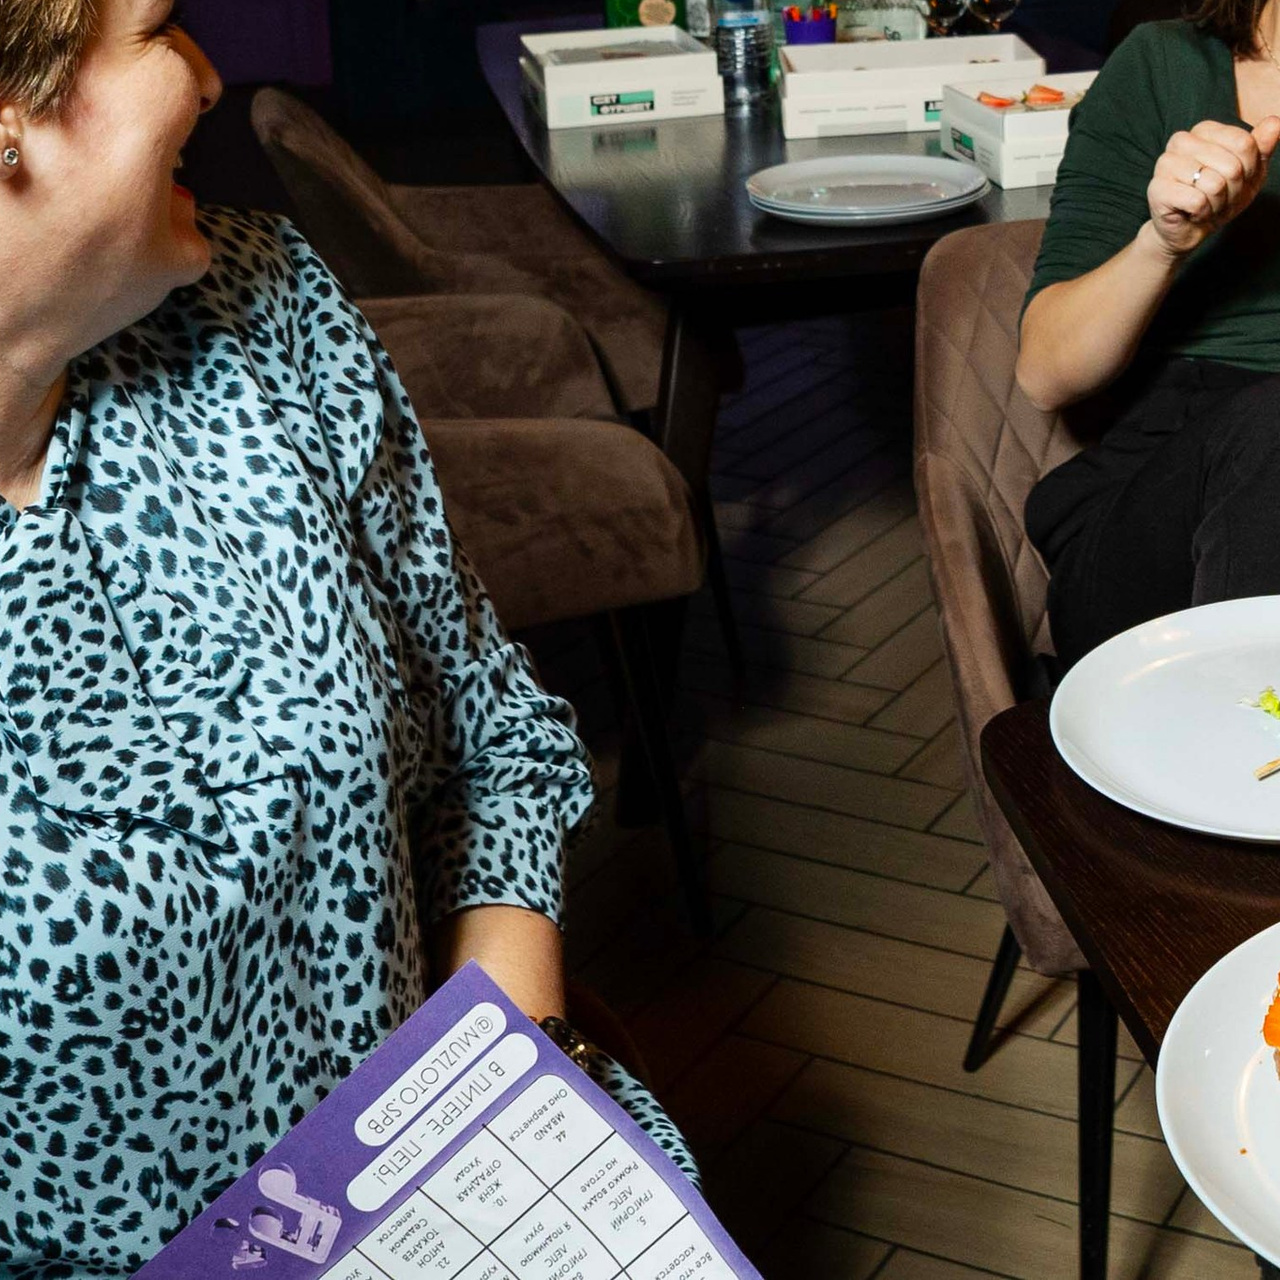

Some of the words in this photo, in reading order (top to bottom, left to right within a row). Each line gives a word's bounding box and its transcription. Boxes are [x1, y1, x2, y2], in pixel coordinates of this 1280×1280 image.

[367, 1015, 495, 1134] @MUZLOTO.SPB
[487, 1059, 506, 1078] В
[427, 1076, 493, 1136] ПИТЕРЕ
[547, 1087, 568, 1107] Она
[508, 1103, 549, 1142] вернется
[533, 1110, 566, 1141] MBAND
[551, 1129, 567, 1143] 44.
[372, 1142, 423, 1186] ПЕТЬ!
[452, 1156, 482, 1184] Уходи
[604, 1157, 618, 1171] на
[606, 1160, 639, 1190] Рюмка
[455, 1158, 502, 1203] ОТРАДНАЯ
[476, 1177, 503, 1204] ЖЕНЯ
[579, 1168, 606, 1193] столе
[581, 1186, 608, 1212] водки
[607, 1185, 633, 1211] ЛЕПС
[609, 1188, 654, 1232] ГРИГОРИЙ
[375, 1206, 416, 1245] лепесток
[388, 1217, 429, 1255] Седьмой
[522, 1221, 545, 1244] руки
[562, 1220, 572, 1231] Я
[401, 1227, 440, 1263] ТОКАРЕВ
[415, 1239, 445, 1269] АНТОН
[519, 1226, 564, 1268] поднимаю
[543, 1243, 568, 1268] ЛЕПС
[434, 1255, 451, 1270] 23.
[547, 1247, 588, 1280] ГРИГОРИ
